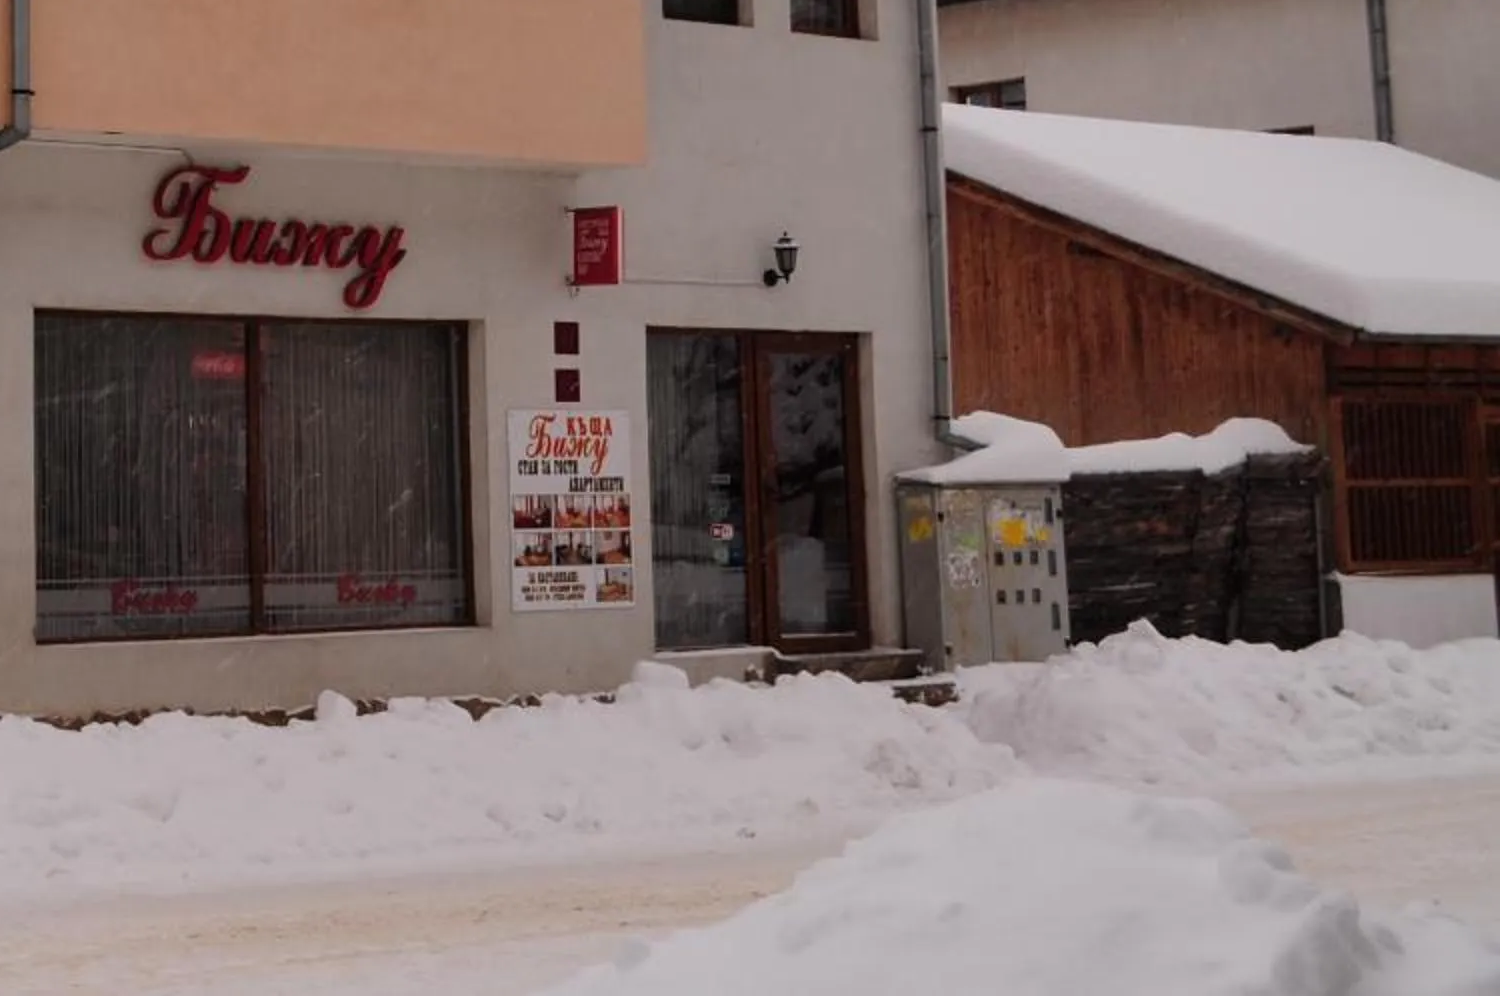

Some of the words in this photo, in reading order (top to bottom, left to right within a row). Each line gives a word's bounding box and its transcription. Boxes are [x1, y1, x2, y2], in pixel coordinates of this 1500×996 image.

[142, 163, 407, 310] Бижу
[526, 414, 608, 476] Бижу
[567, 416, 612, 436] КЪЩА
